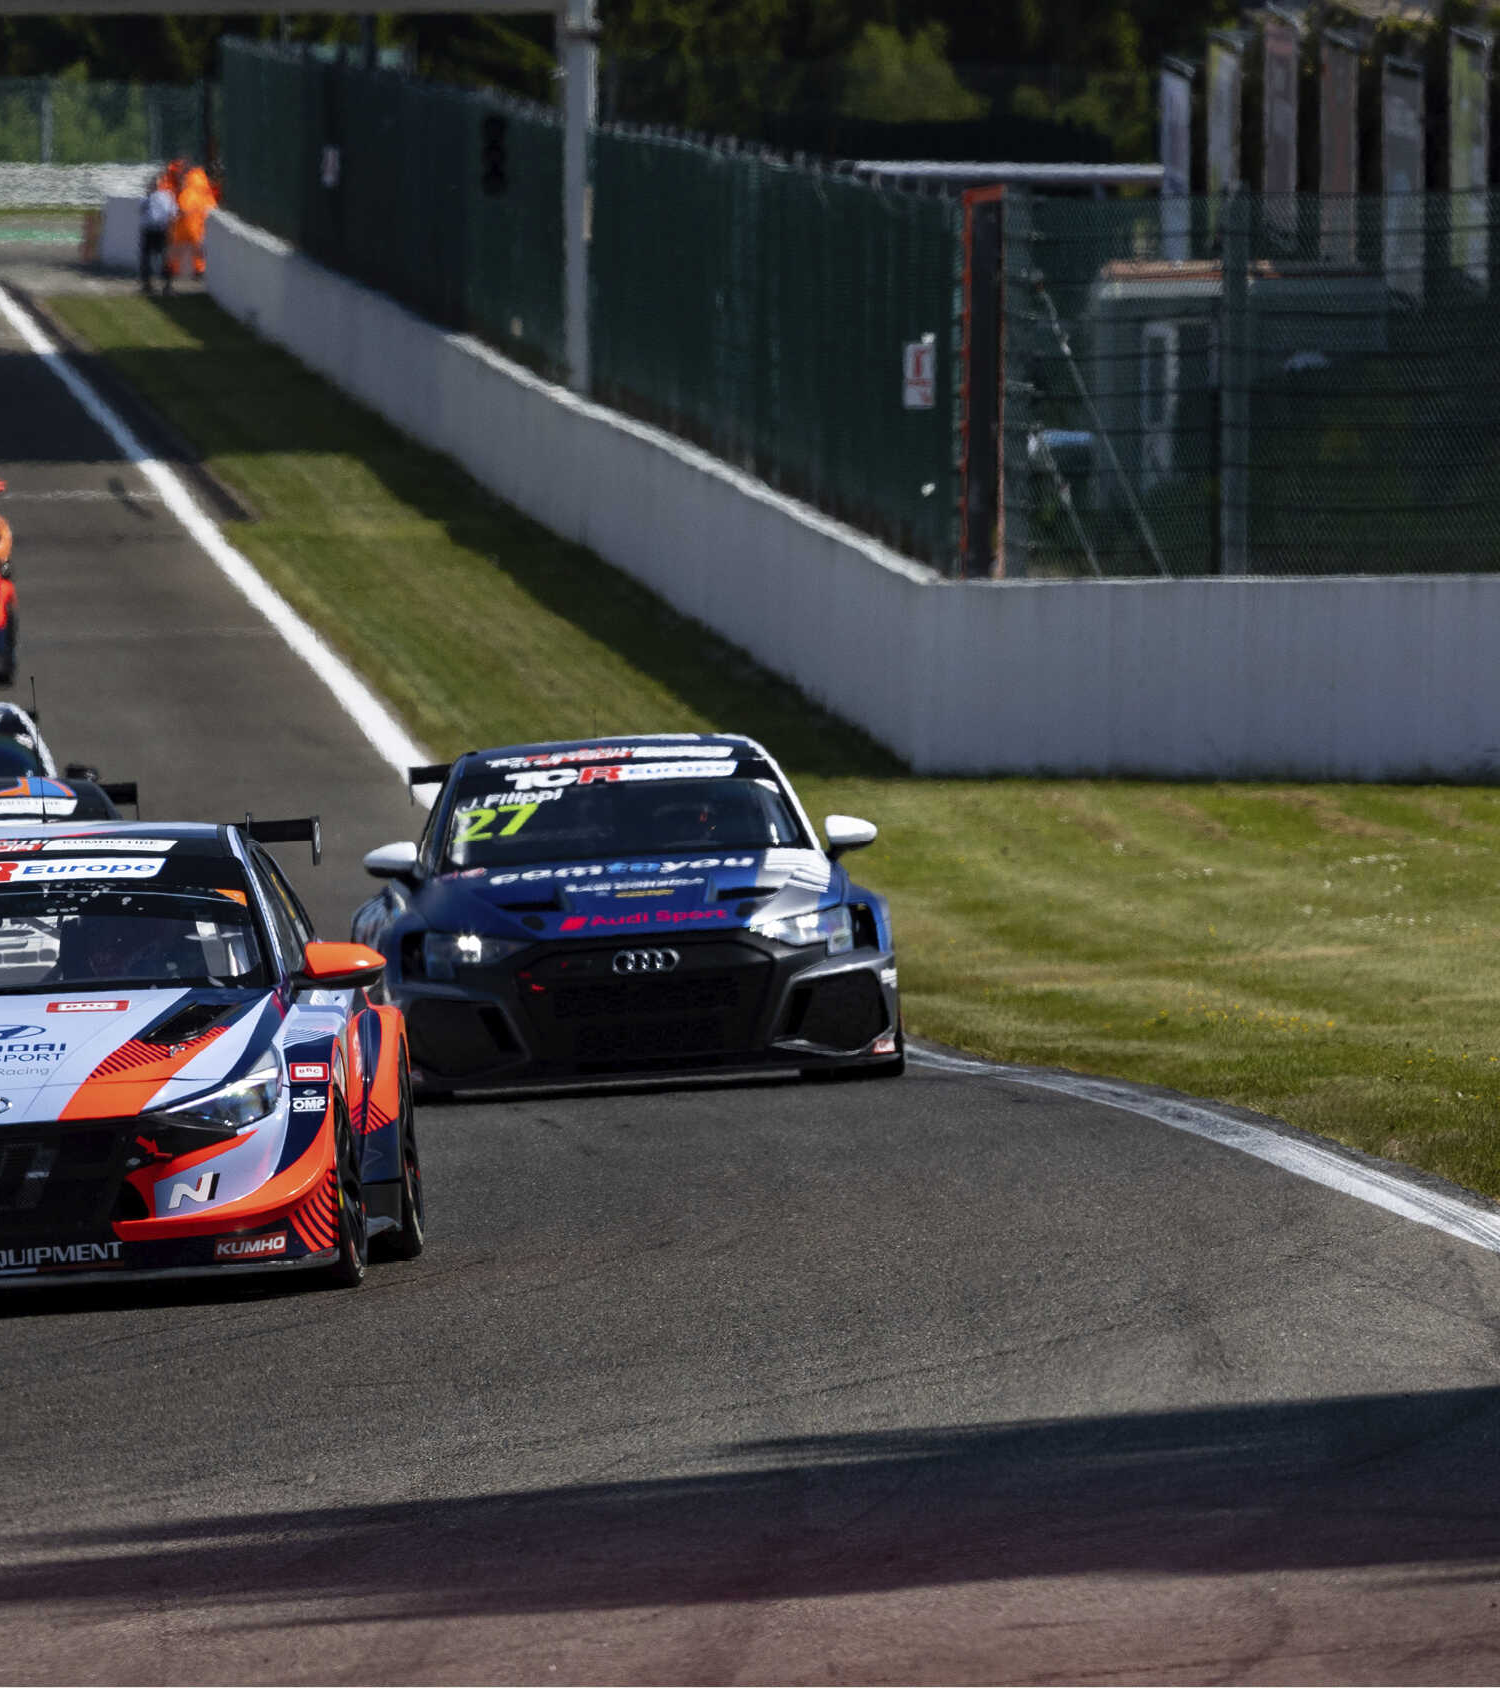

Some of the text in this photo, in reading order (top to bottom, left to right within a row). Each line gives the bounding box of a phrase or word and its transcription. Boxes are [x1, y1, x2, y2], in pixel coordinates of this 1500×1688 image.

[504, 766, 623, 791] TCR
[452, 802, 539, 843] 27
[22, 862, 156, 877] Europe
[591, 908, 728, 926] Audi Sport
[292, 1098, 326, 1110] OMP
[216, 1235, 286, 1256] KUMHO
